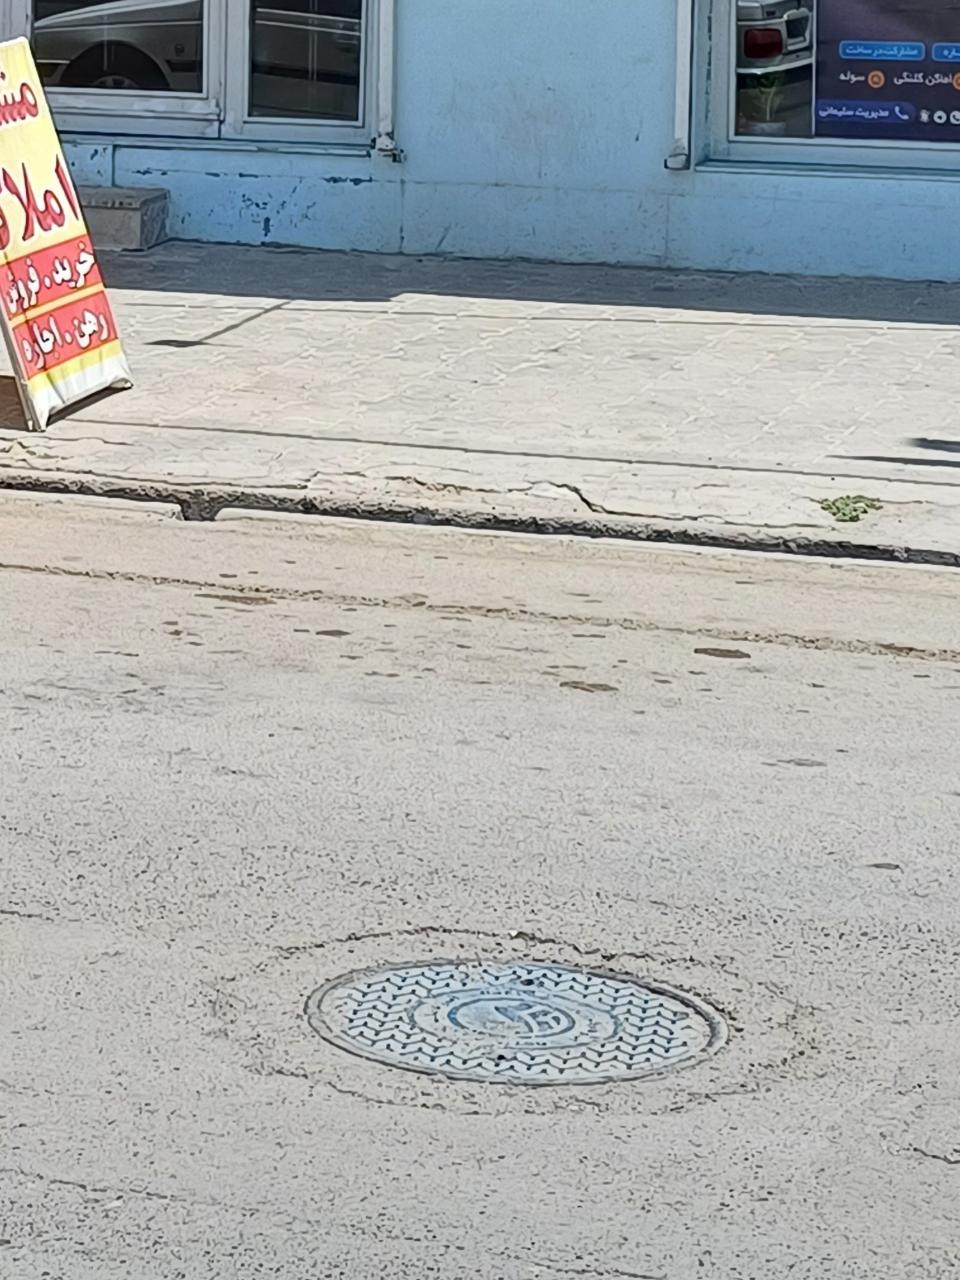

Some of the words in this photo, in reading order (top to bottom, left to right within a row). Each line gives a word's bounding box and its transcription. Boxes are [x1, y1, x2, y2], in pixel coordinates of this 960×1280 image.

[840, 70, 865, 83] سوله
[7, 257, 40, 315] فروش
[51, 240, 96, 288] خرید
[21, 314, 64, 370] اجاره
[73, 309, 110, 349] رهن
